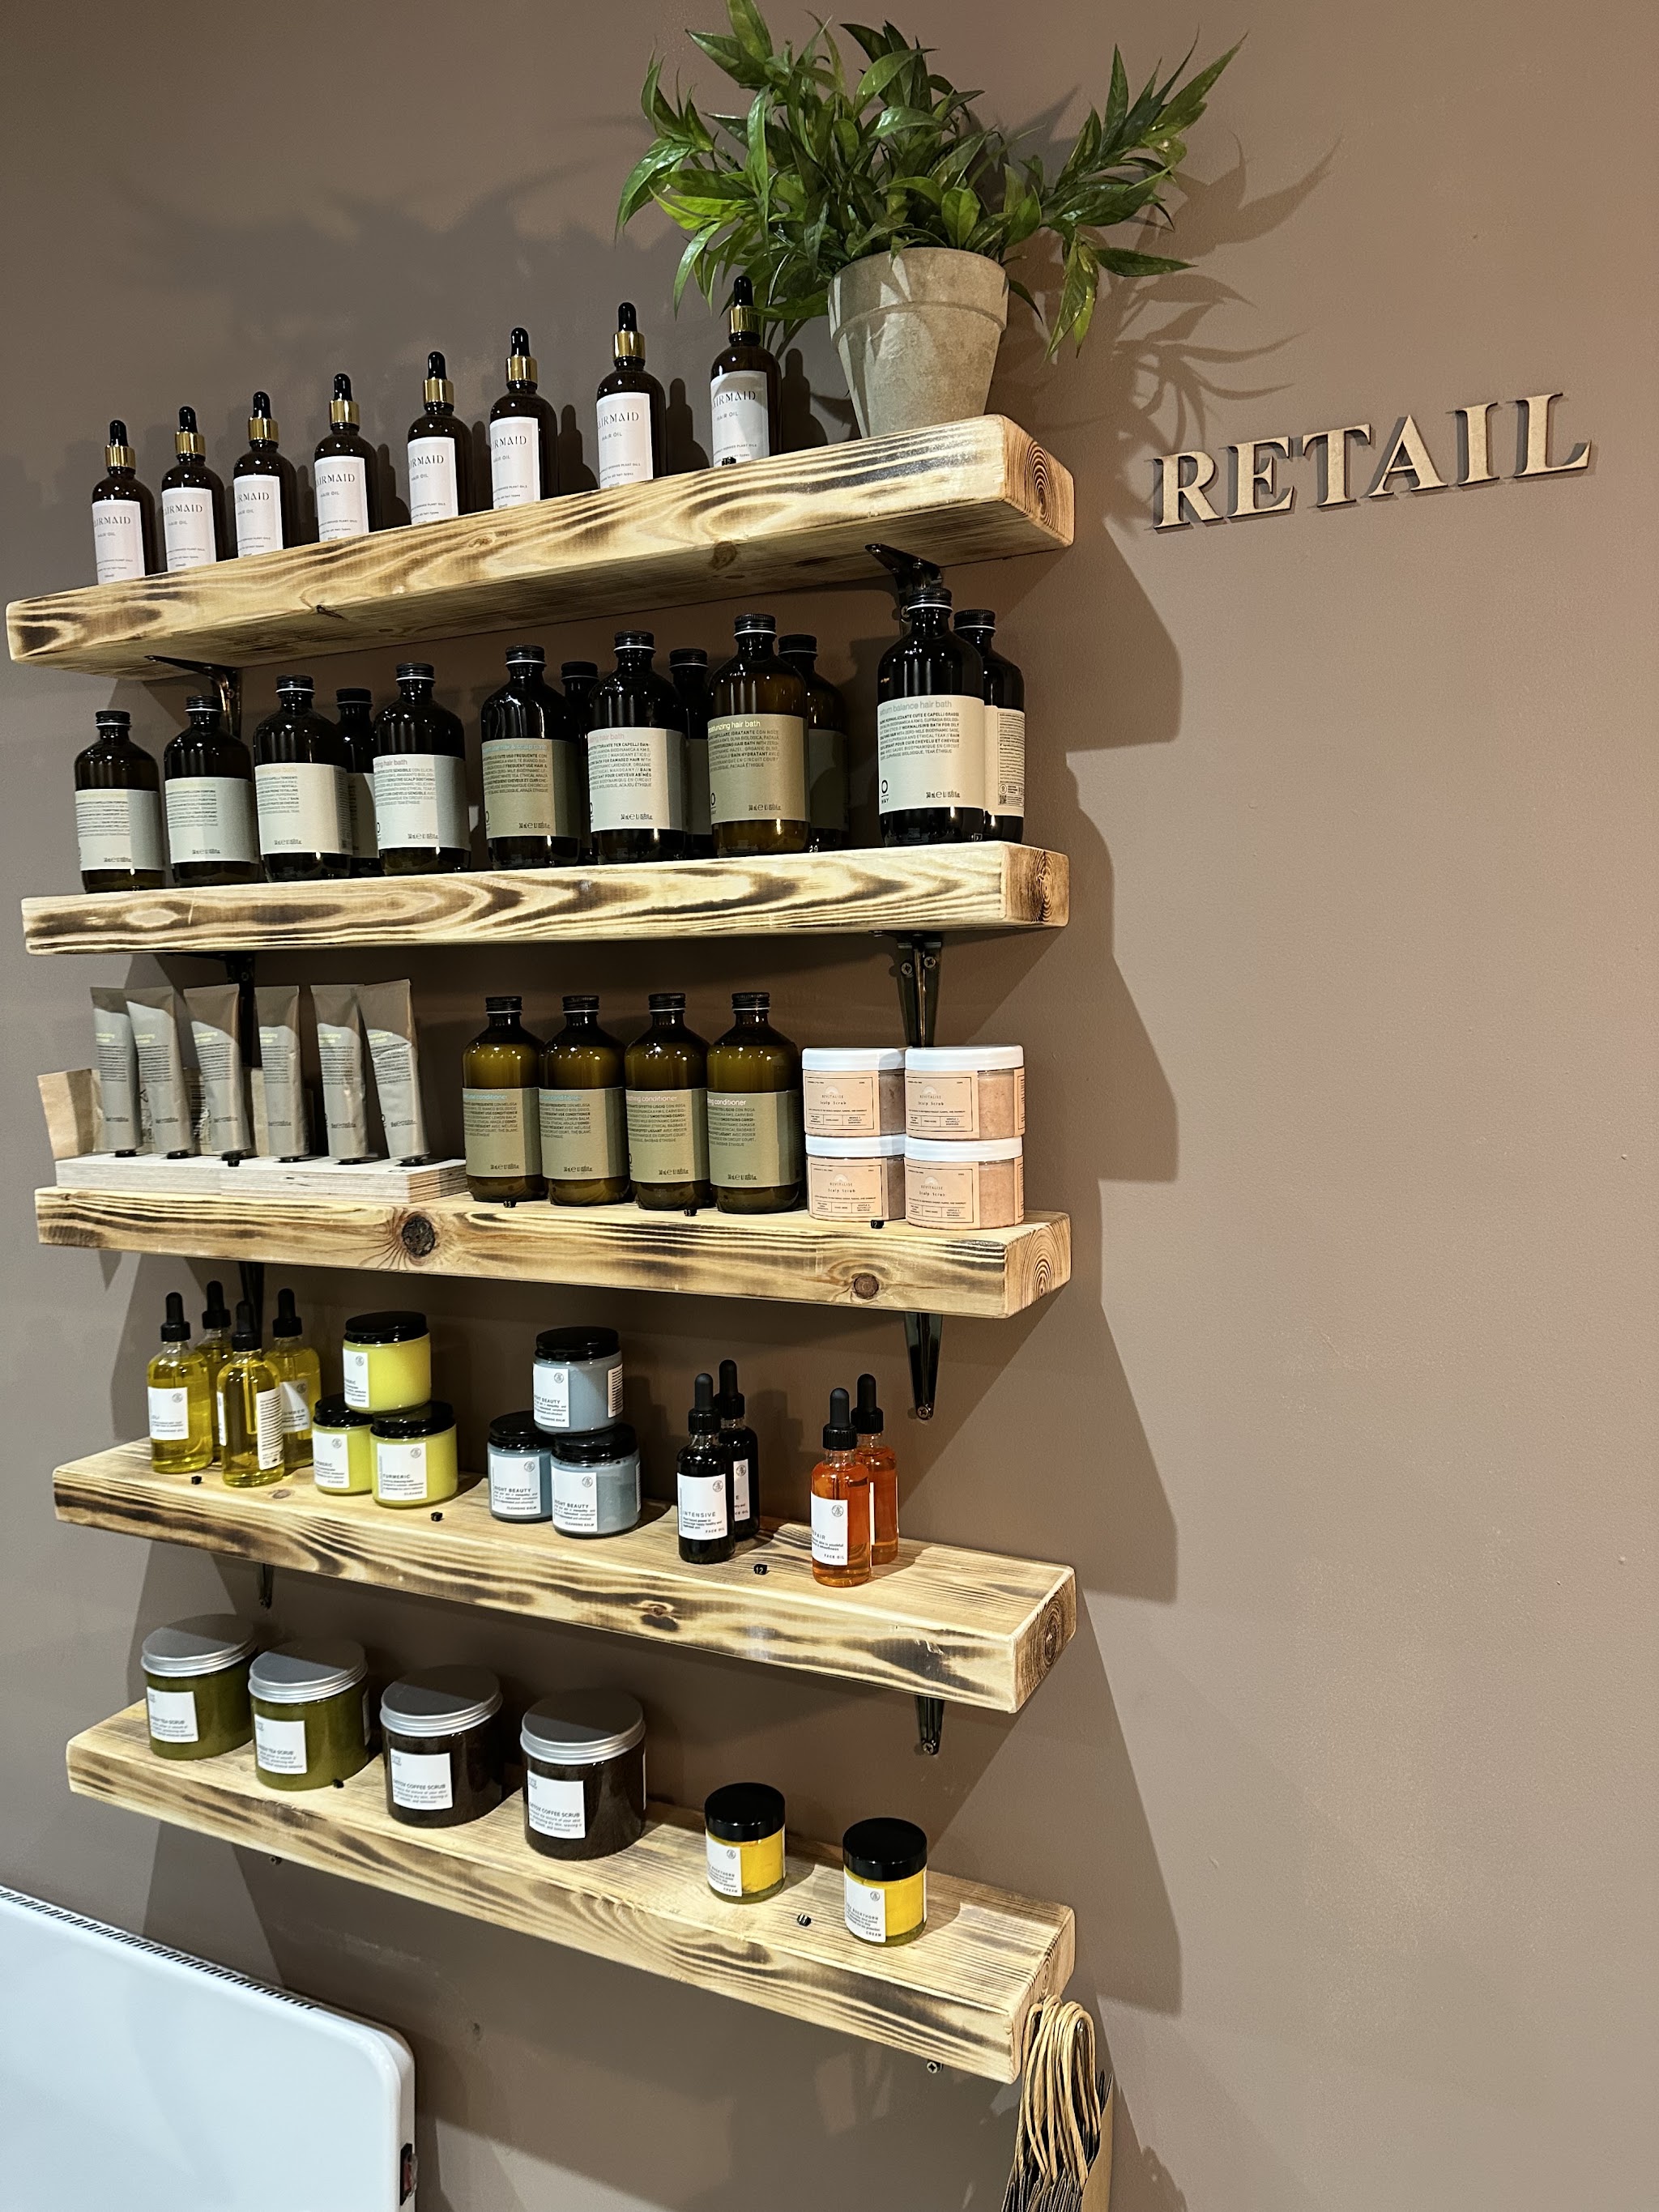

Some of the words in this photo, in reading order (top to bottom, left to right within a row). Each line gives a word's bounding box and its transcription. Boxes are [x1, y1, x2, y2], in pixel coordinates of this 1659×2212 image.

[1152, 392, 1592, 530] RETAIL
[893, 703, 919, 713] balance
[920, 701, 934, 709] hair
[935, 700, 952, 708] bath
[731, 720, 744, 728] hair
[542, 1808, 561, 1817] COFFEE
